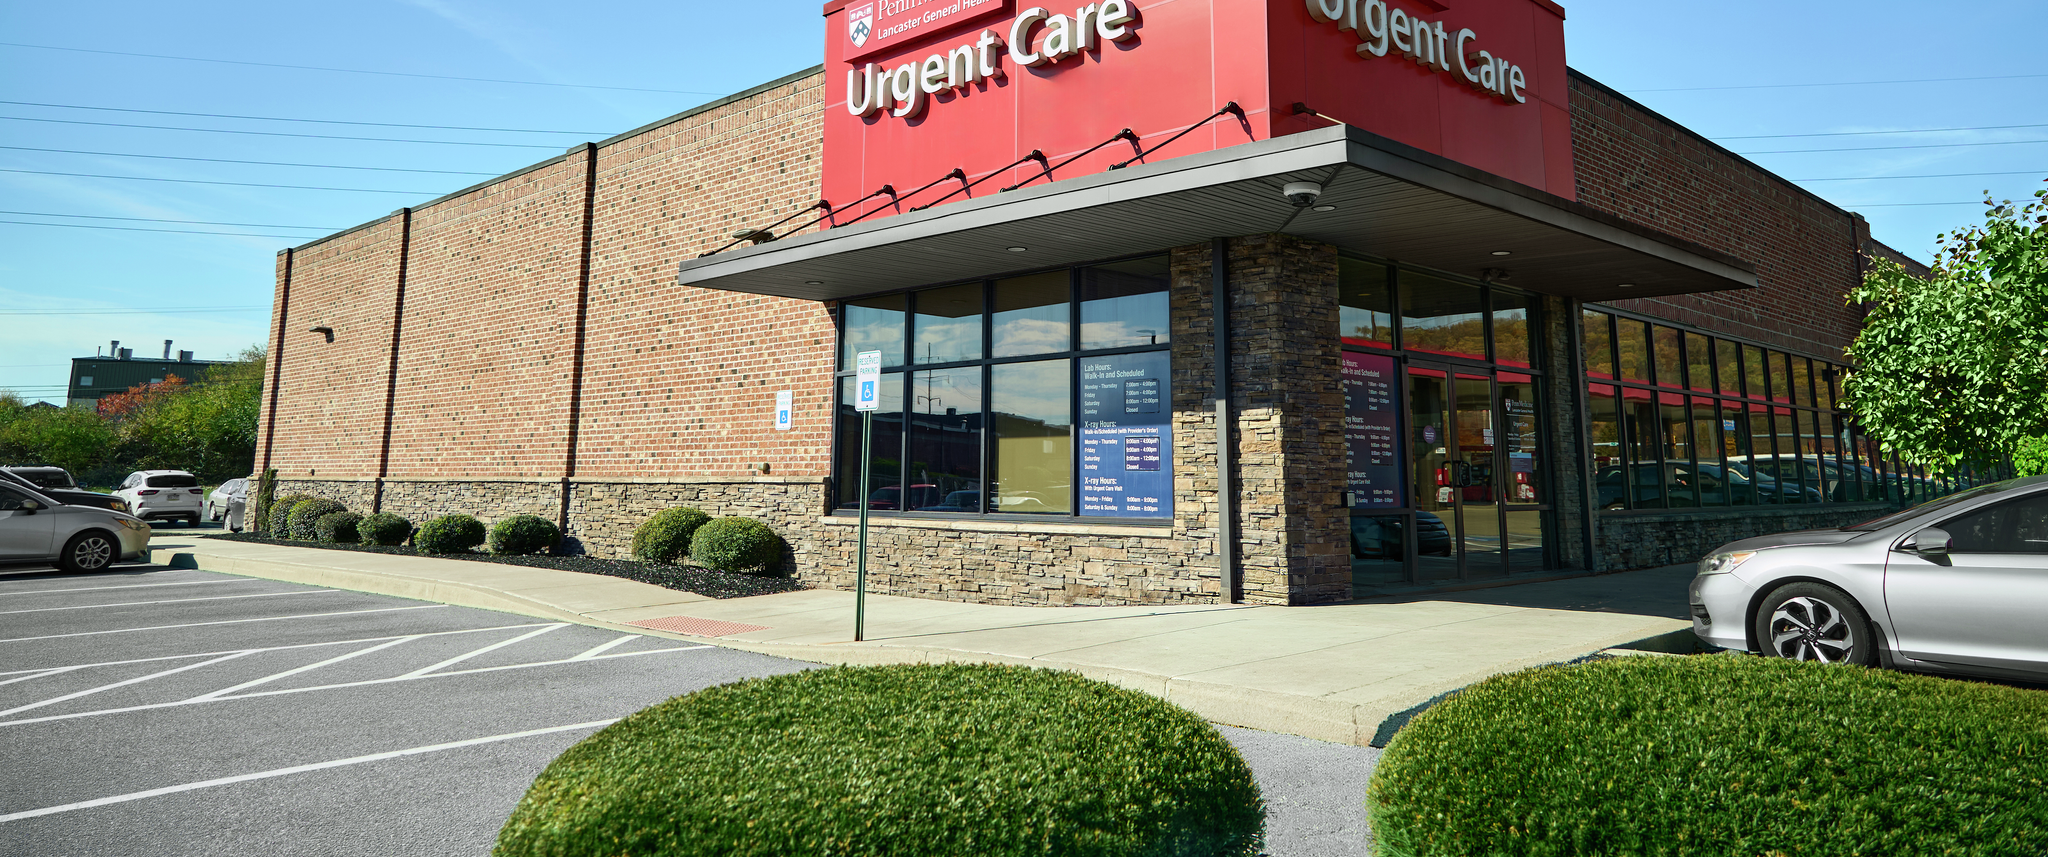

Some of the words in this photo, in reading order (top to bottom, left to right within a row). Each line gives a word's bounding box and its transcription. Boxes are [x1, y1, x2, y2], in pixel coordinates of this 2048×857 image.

[878, 17, 922, 40] Lancaster
[923, 0, 961, 23] General
[847, 28, 1001, 118] Urgent
[1009, 0, 1131, 66] Care
[1455, 28, 1526, 105] Care
[1117, 369, 1144, 378] Scheduled
[1084, 420, 1098, 429] X-ray
[1084, 477, 1099, 485] X-ray
